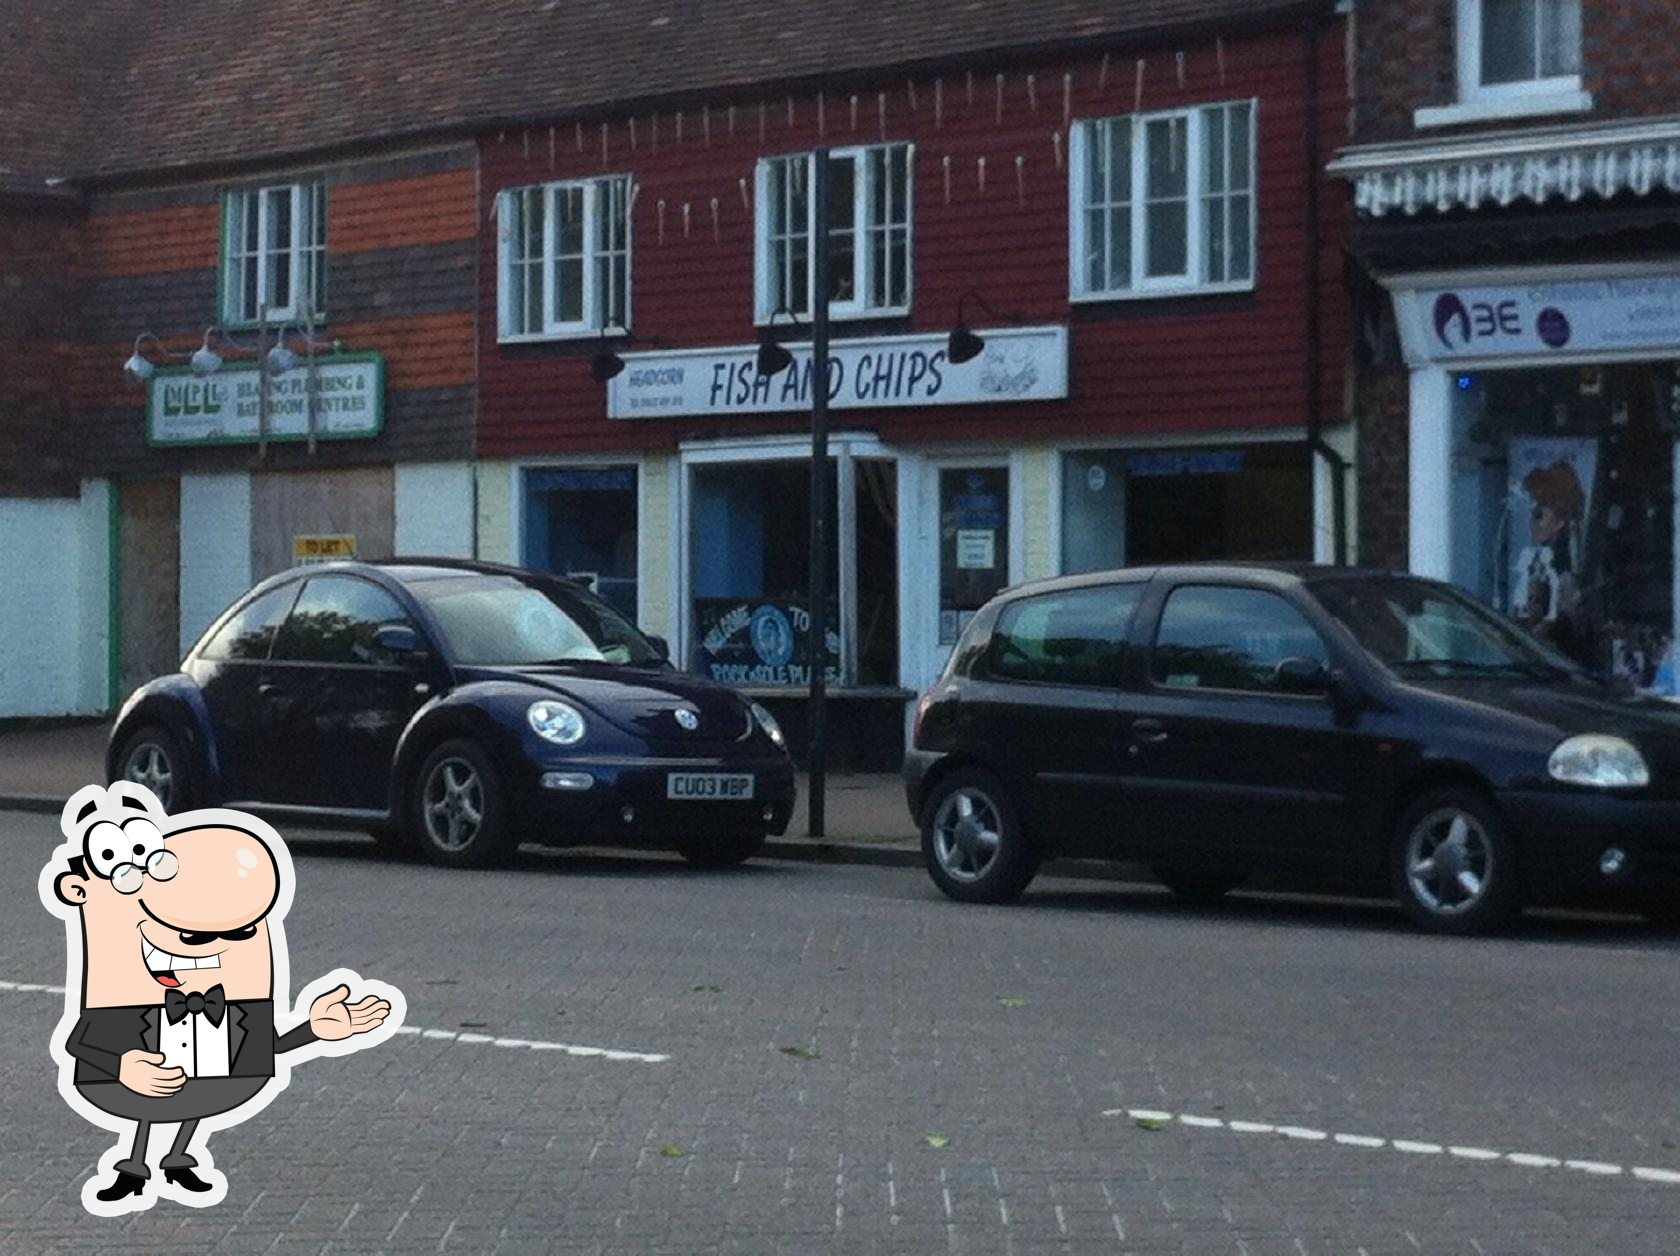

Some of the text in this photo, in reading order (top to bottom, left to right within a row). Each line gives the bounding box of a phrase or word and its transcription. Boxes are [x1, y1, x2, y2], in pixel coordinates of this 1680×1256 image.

[709, 360, 773, 406] FISH
[855, 350, 946, 399] CHIPS
[788, 606, 810, 631] TO
[673, 776, 717, 796] CU03
